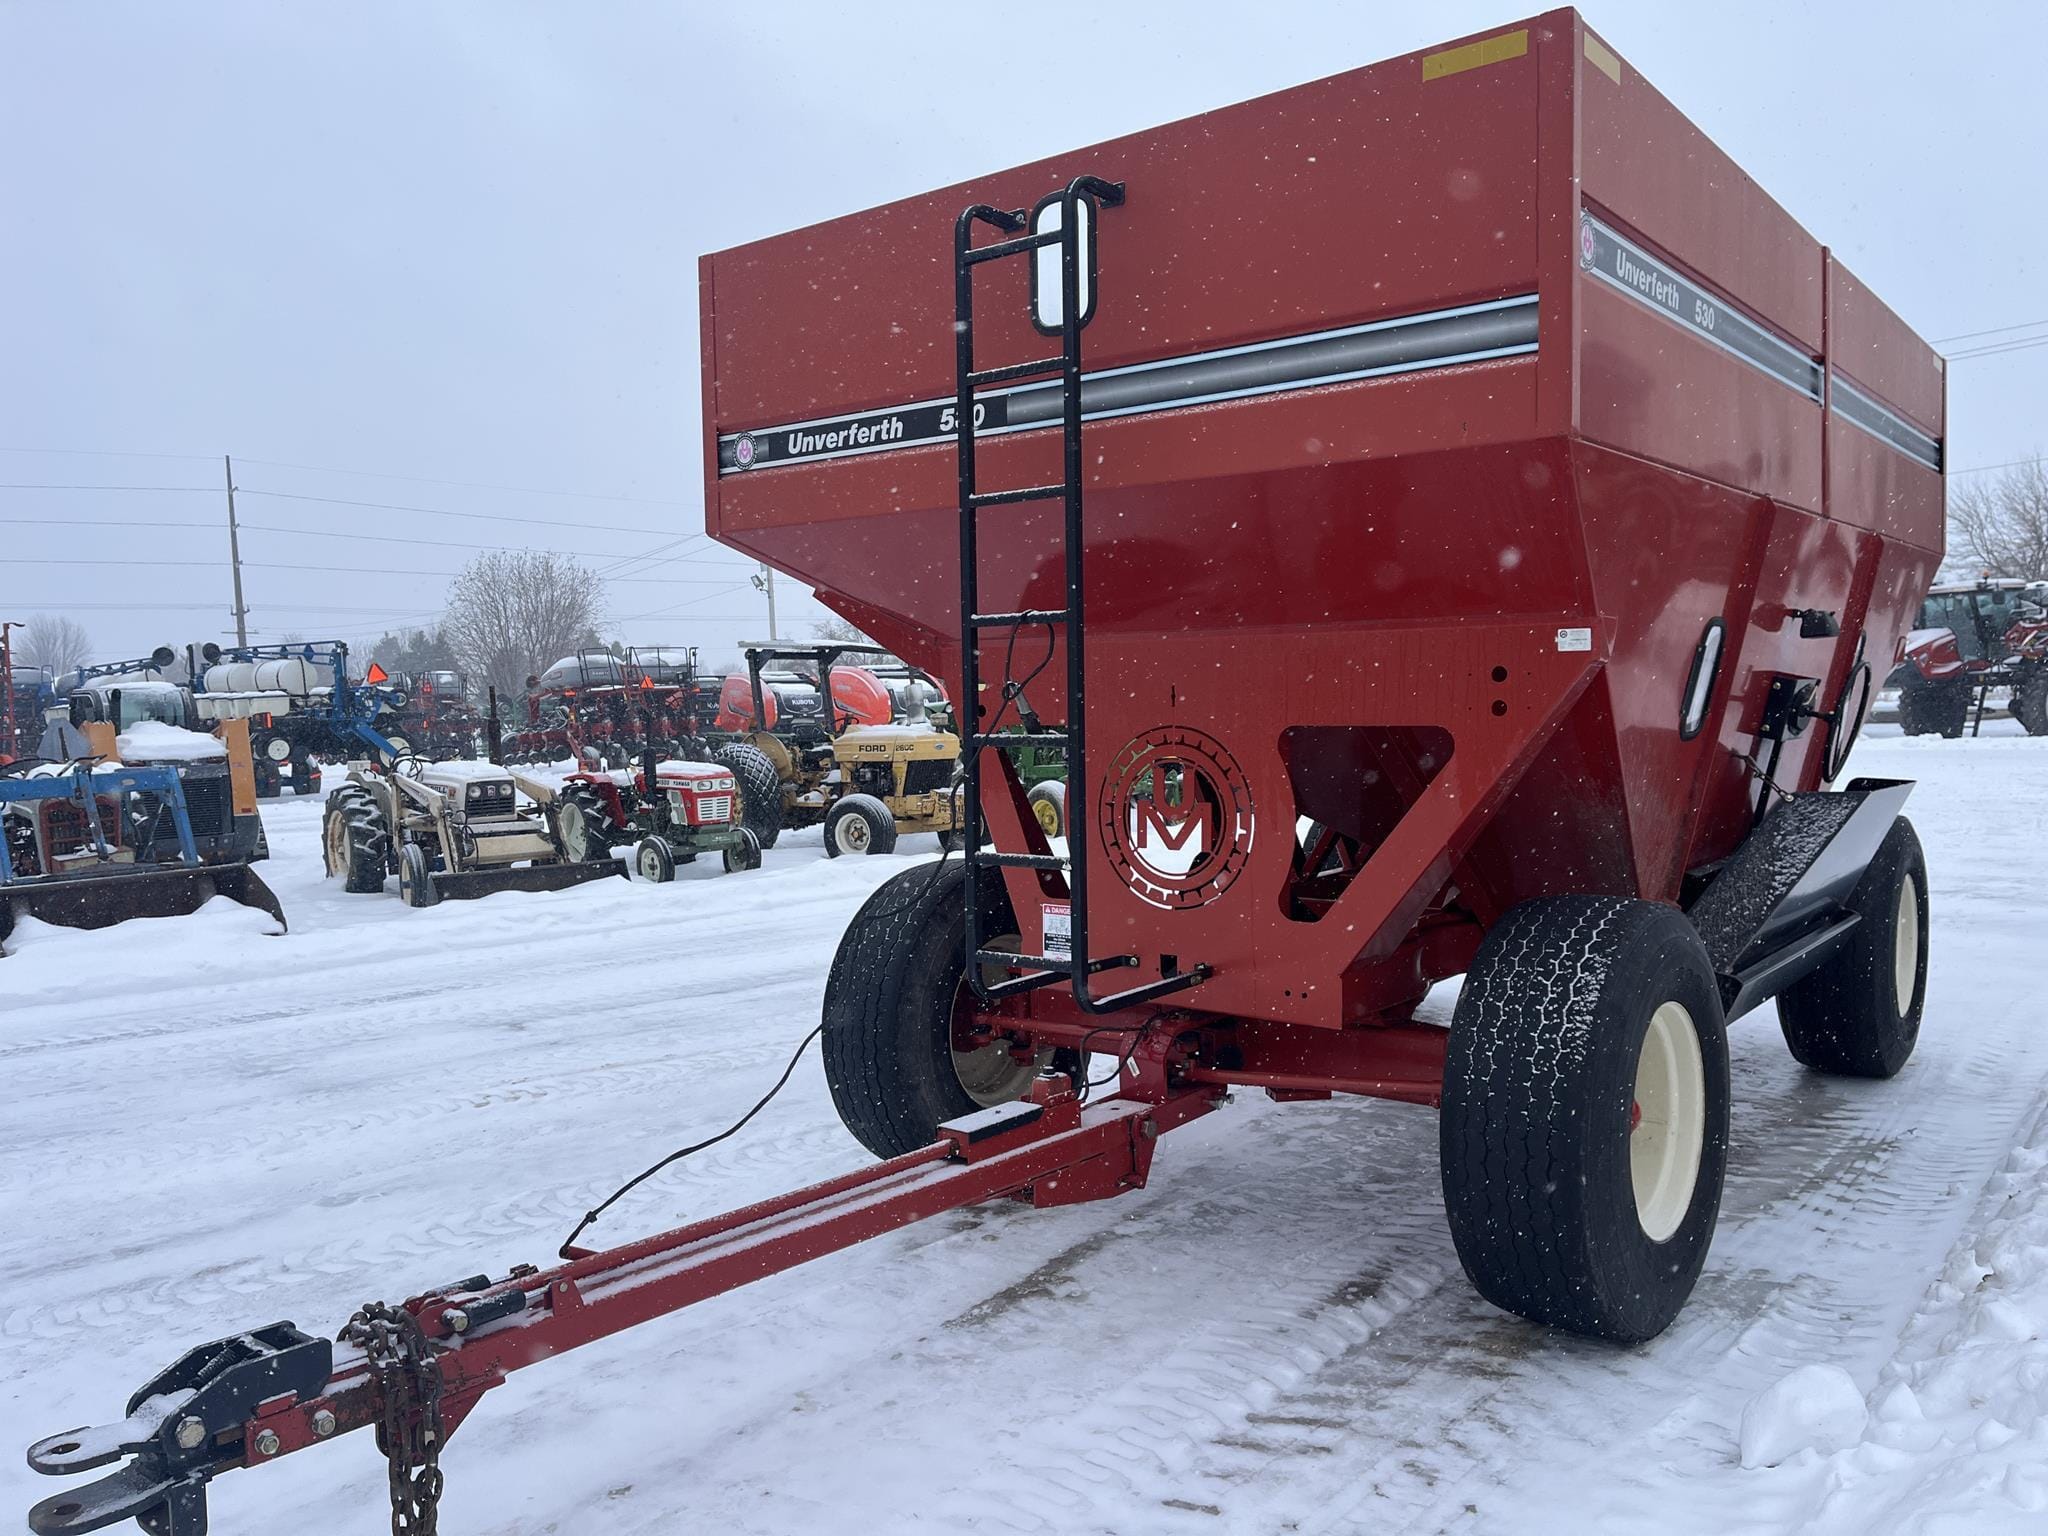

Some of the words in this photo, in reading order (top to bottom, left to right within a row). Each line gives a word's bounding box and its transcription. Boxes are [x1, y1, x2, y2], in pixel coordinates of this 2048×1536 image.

[1616, 249, 1680, 311] Unverferth
[1695, 299, 1715, 330] 530
[788, 417, 903, 455] Unverferth
[858, 744, 887, 752] FORD
[1051, 906, 1072, 916] DANGE
